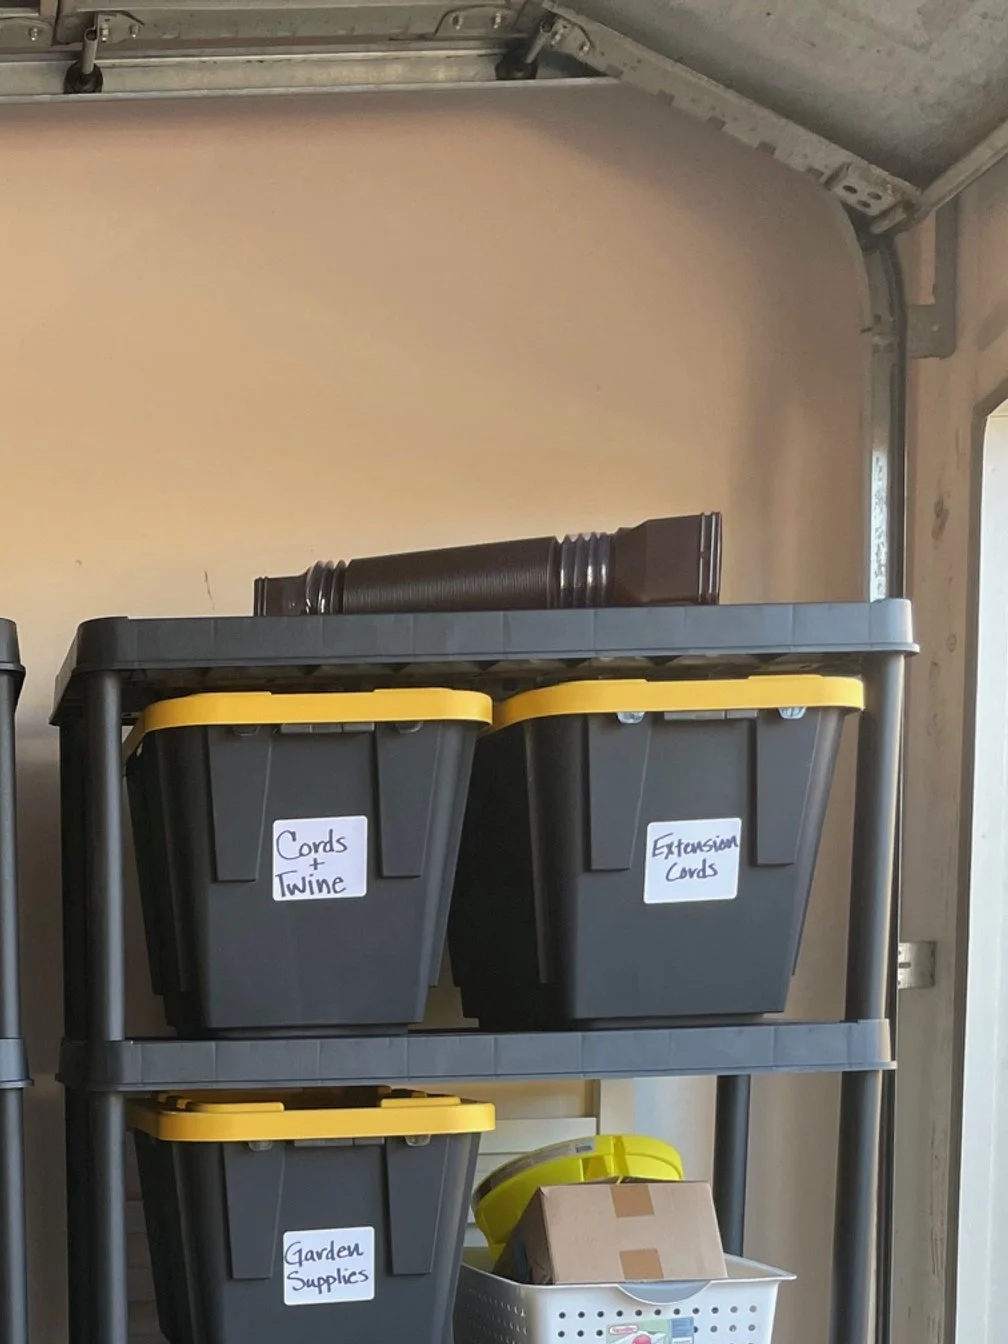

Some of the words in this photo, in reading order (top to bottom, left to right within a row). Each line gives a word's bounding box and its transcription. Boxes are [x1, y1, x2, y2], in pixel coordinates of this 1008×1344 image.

[276, 828, 348, 860] Cords
[652, 833, 739, 860] Extension
[309, 857, 325, 871] +
[665, 859, 718, 882] Cords
[275, 870, 347, 897] Twine
[284, 1240, 364, 1267] Garden
[286, 1267, 369, 1295] Supplies
